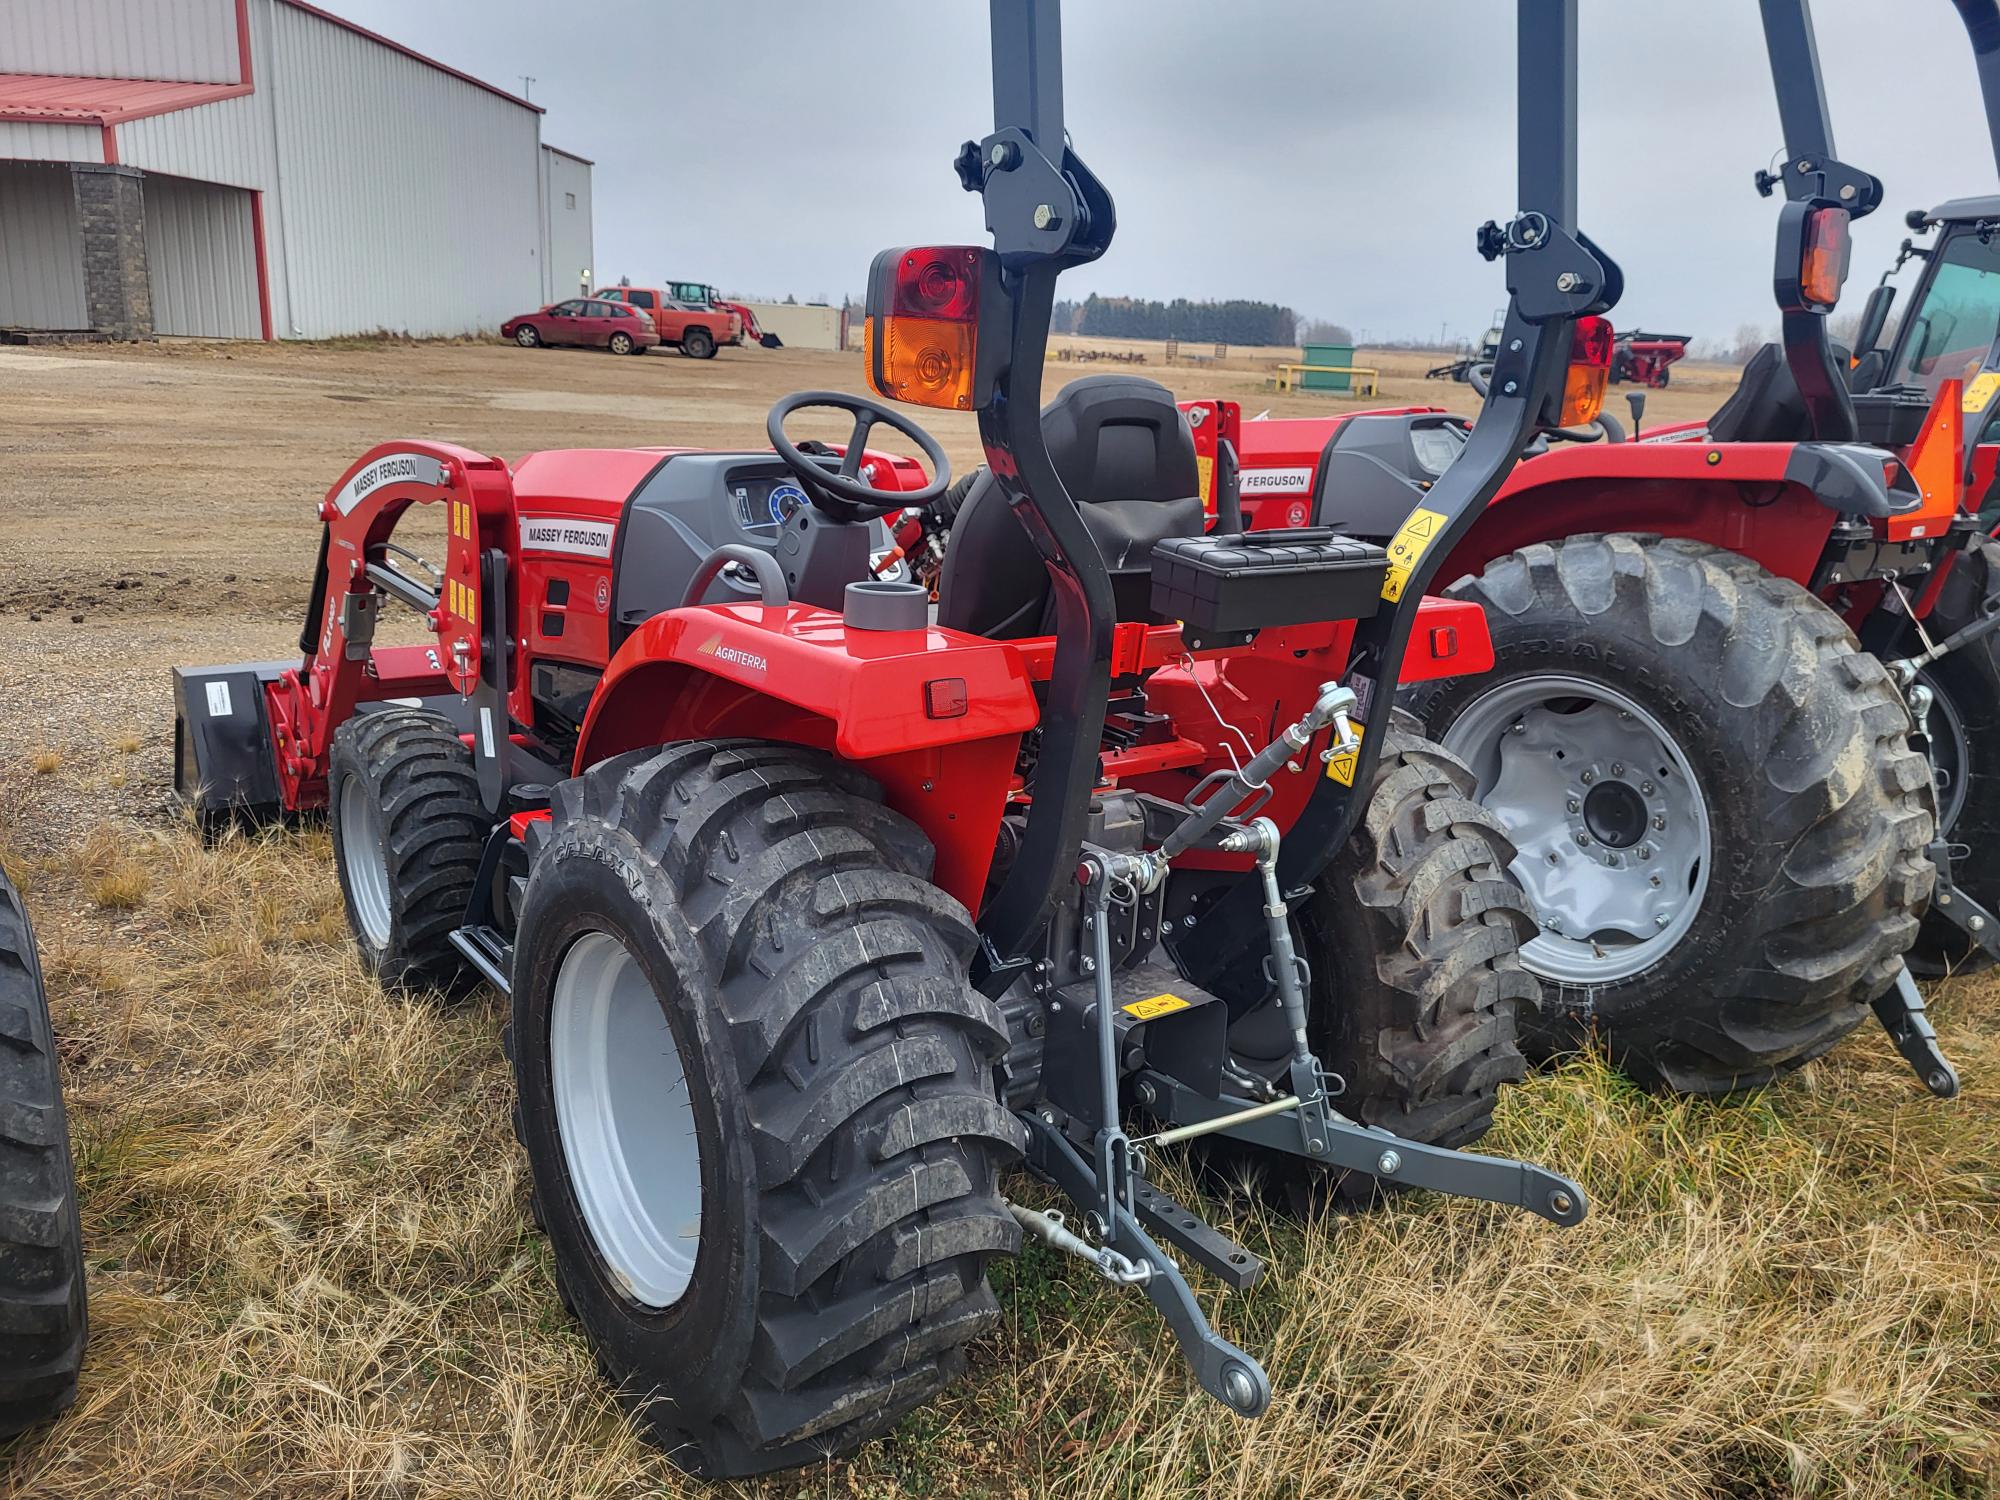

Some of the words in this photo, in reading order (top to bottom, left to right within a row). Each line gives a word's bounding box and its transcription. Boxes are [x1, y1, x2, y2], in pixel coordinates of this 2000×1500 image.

[353, 466, 378, 497] MASSEY
[379, 458, 417, 481] FERGUSON
[1247, 475, 1305, 487] FERGUSON
[528, 527, 562, 543] MASSEY
[563, 529, 609, 548] FERGUSON
[714, 645, 767, 672] AGRITERRA
